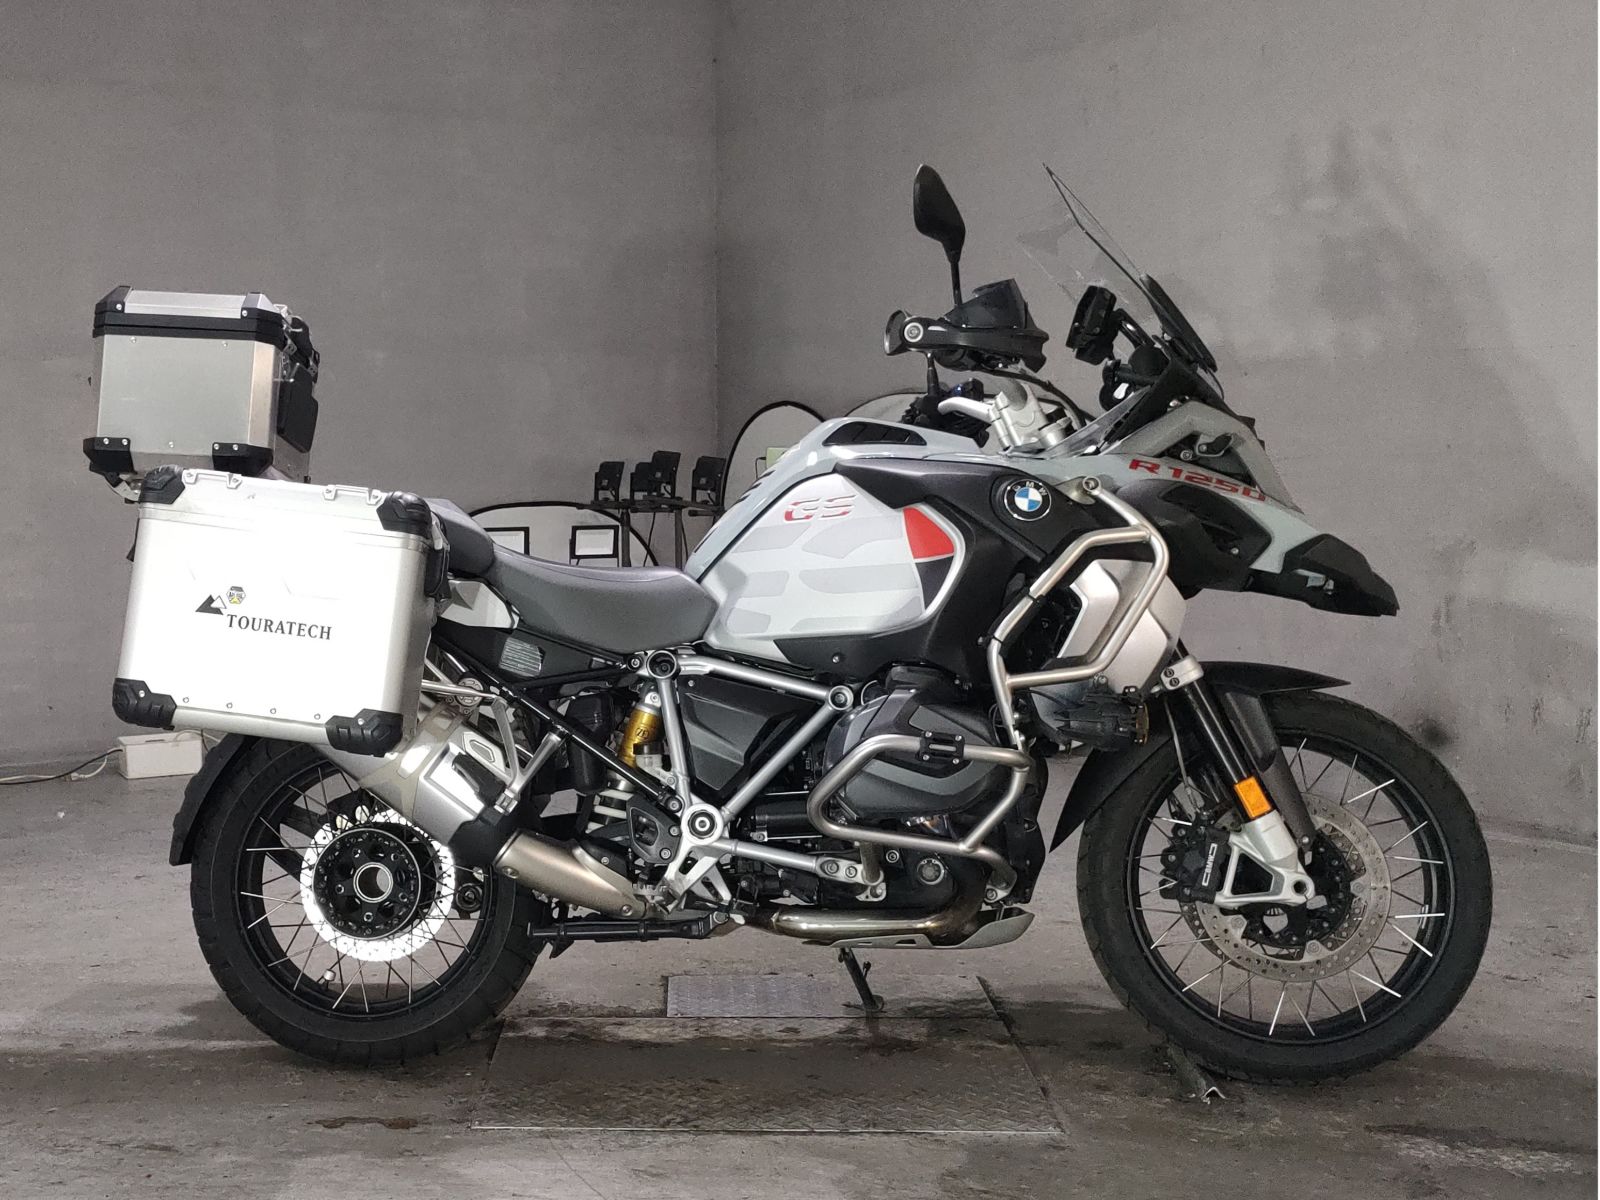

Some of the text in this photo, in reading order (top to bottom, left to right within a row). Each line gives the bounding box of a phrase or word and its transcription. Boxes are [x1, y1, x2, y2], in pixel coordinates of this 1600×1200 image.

[1012, 480, 1048, 496] BMW
[1129, 458, 1266, 502] R 1250
[784, 494, 857, 522] GS
[226, 613, 333, 641] TOURATECH
